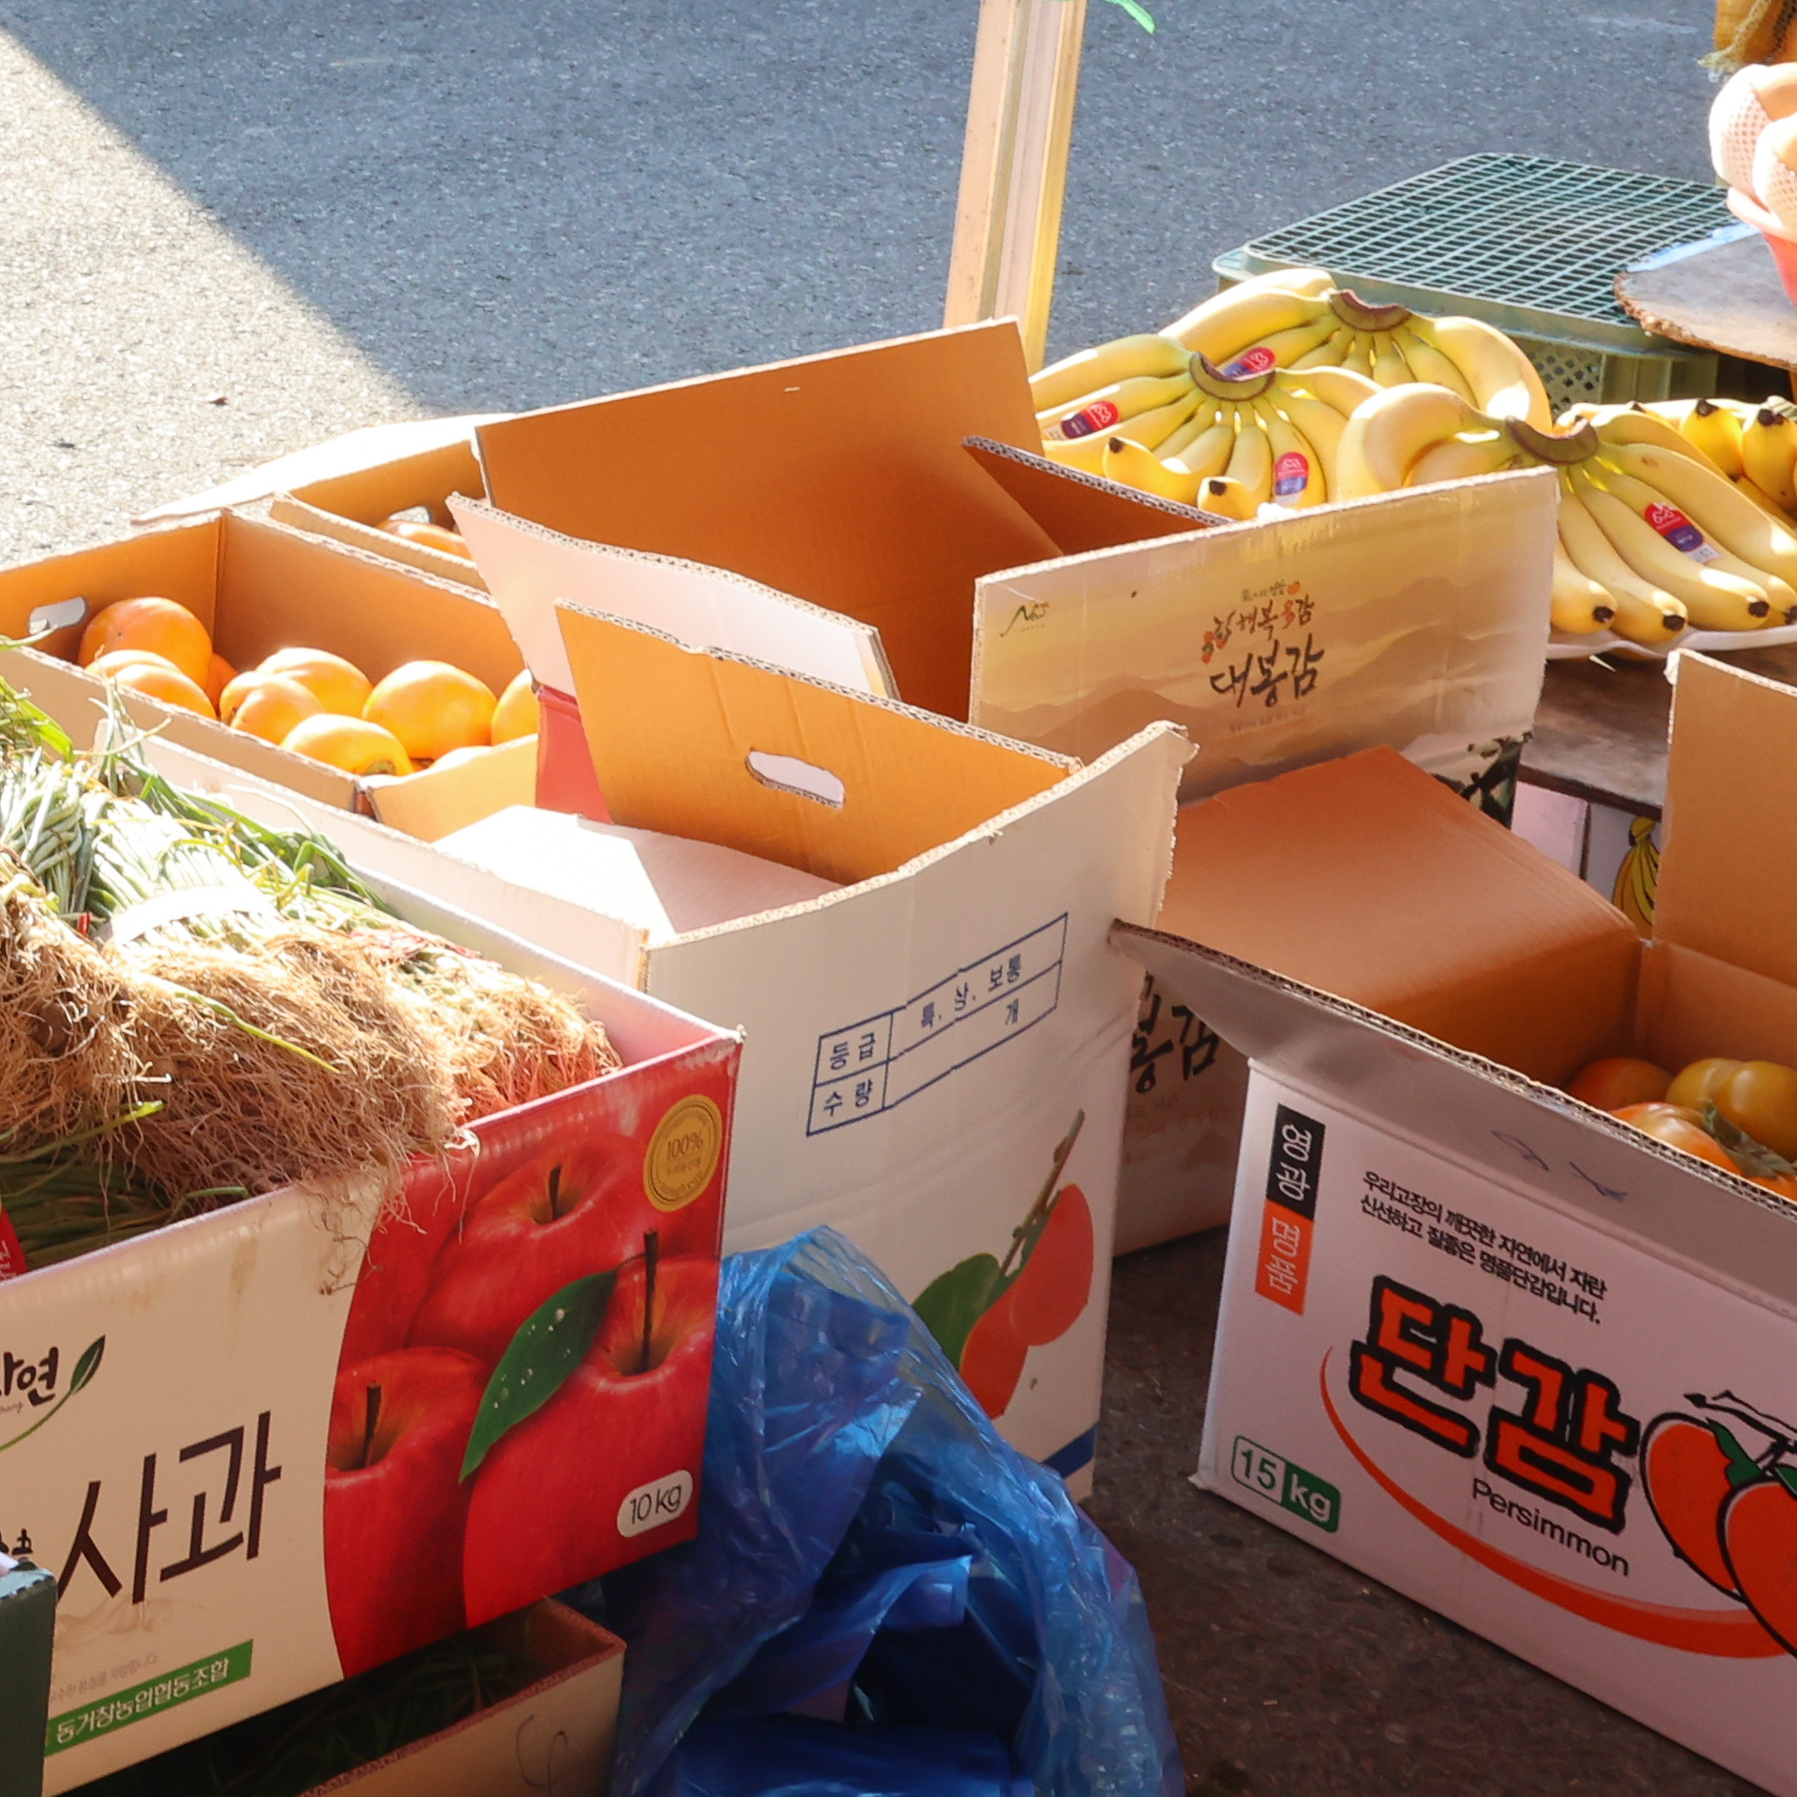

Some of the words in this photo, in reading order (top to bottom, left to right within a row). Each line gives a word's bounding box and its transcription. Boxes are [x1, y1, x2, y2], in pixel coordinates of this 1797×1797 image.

[1209, 631, 1325, 709] 대봉감
[987, 953, 1022, 993] 보통
[1004, 997, 1020, 1025] 개
[830, 1032, 877, 1071] 등급
[823, 1078, 874, 1117] 수량
[666, 1129, 705, 1161] 100%
[1275, 1123, 1313, 1202] 영광
[1264, 1216, 1301, 1296] 명품
[1359, 1194, 1423, 1239] 신선하고
[1426, 1225, 1477, 1266] 질좋은
[1479, 1250, 1602, 1325] 명품단감입니다.
[1362, 1169, 1443, 1224] 우리고장의
[1445, 1209, 1497, 1245] 깨끗한
[1499, 1234, 1568, 1281] 자연에서
[1569, 1266, 1608, 1302] 자란
[1349, 1274, 1641, 1535] 단감
[57, 1409, 282, 1605] 사과
[1472, 1477, 1631, 1578] Persimmon
